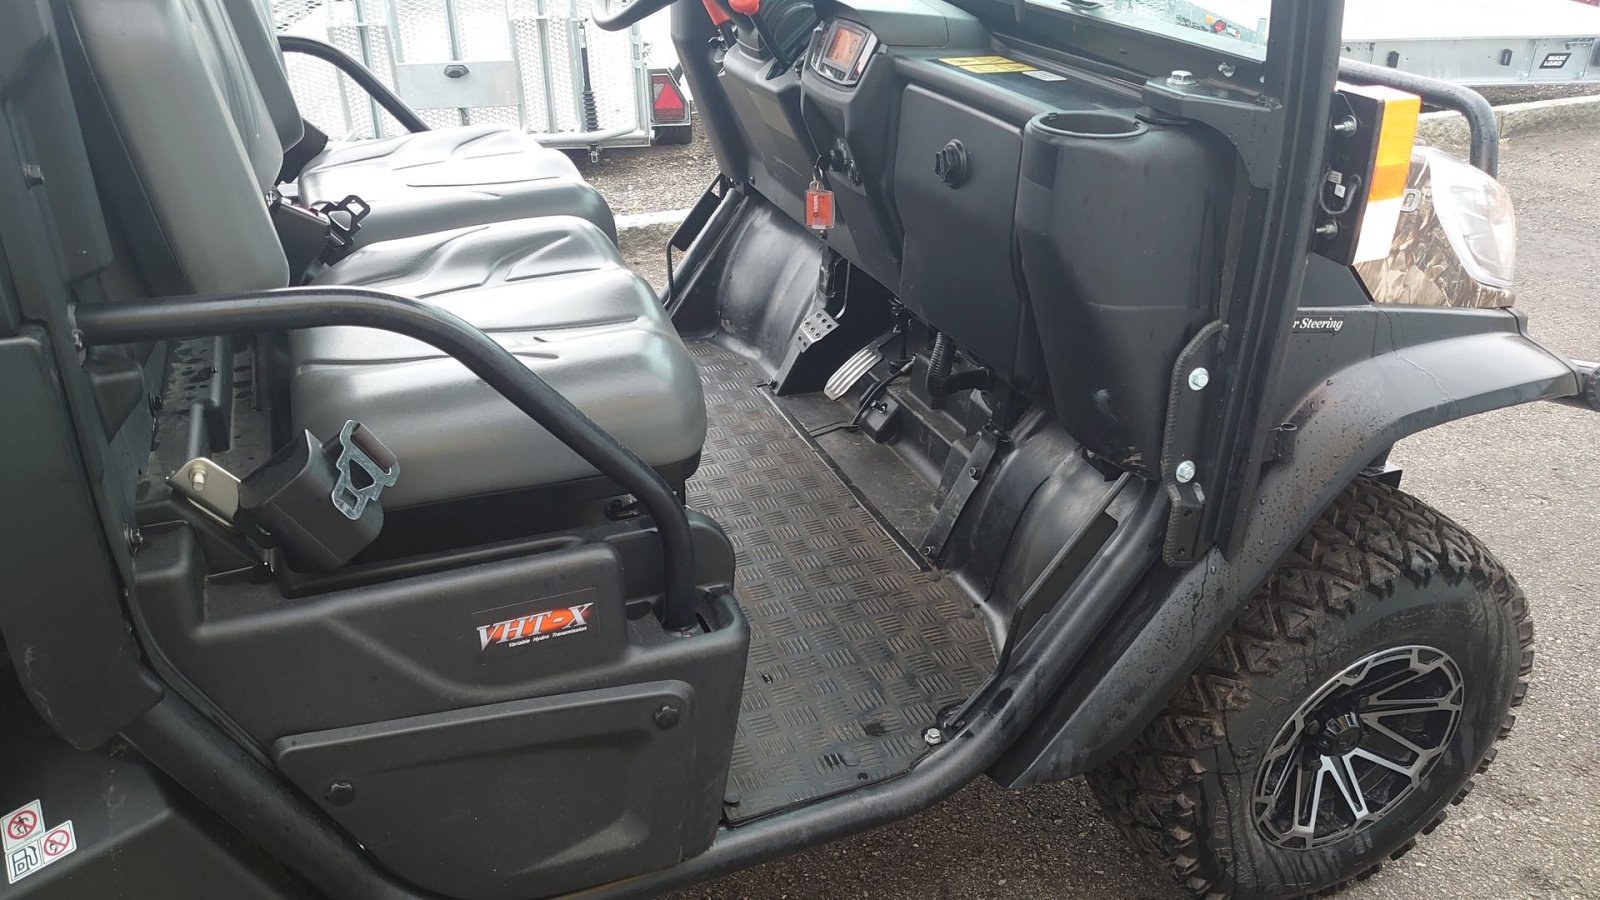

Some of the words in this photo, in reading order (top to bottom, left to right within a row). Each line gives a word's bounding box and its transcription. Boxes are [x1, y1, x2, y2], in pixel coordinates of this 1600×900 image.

[1299, 317, 1344, 331] Steering
[476, 602, 594, 652] VHT-X
[509, 639, 530, 647] Variable
[552, 626, 587, 637] Transmission
